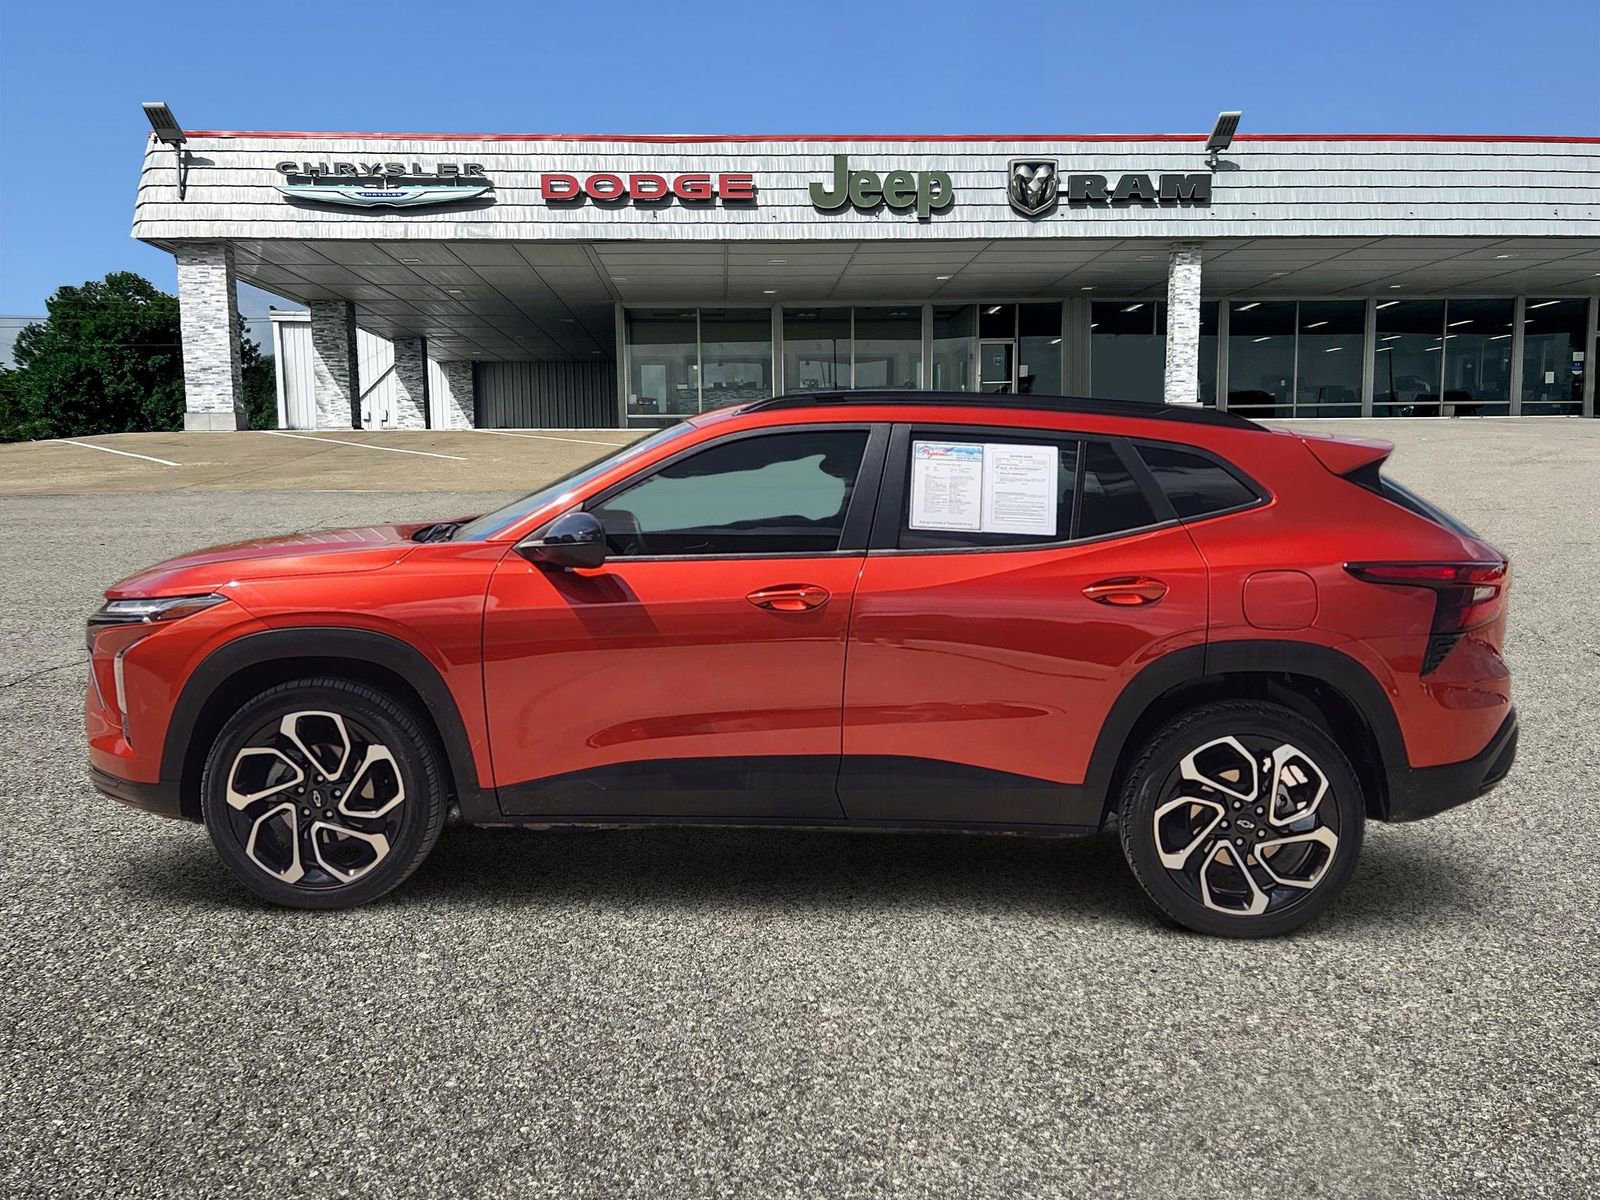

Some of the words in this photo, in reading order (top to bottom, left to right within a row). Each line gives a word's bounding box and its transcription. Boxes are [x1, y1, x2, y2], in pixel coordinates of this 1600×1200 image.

[276, 161, 485, 176] CHRYSLER
[541, 174, 755, 200] DODGE
[809, 155, 953, 220] Jeep
[1068, 174, 1212, 199] RAM
